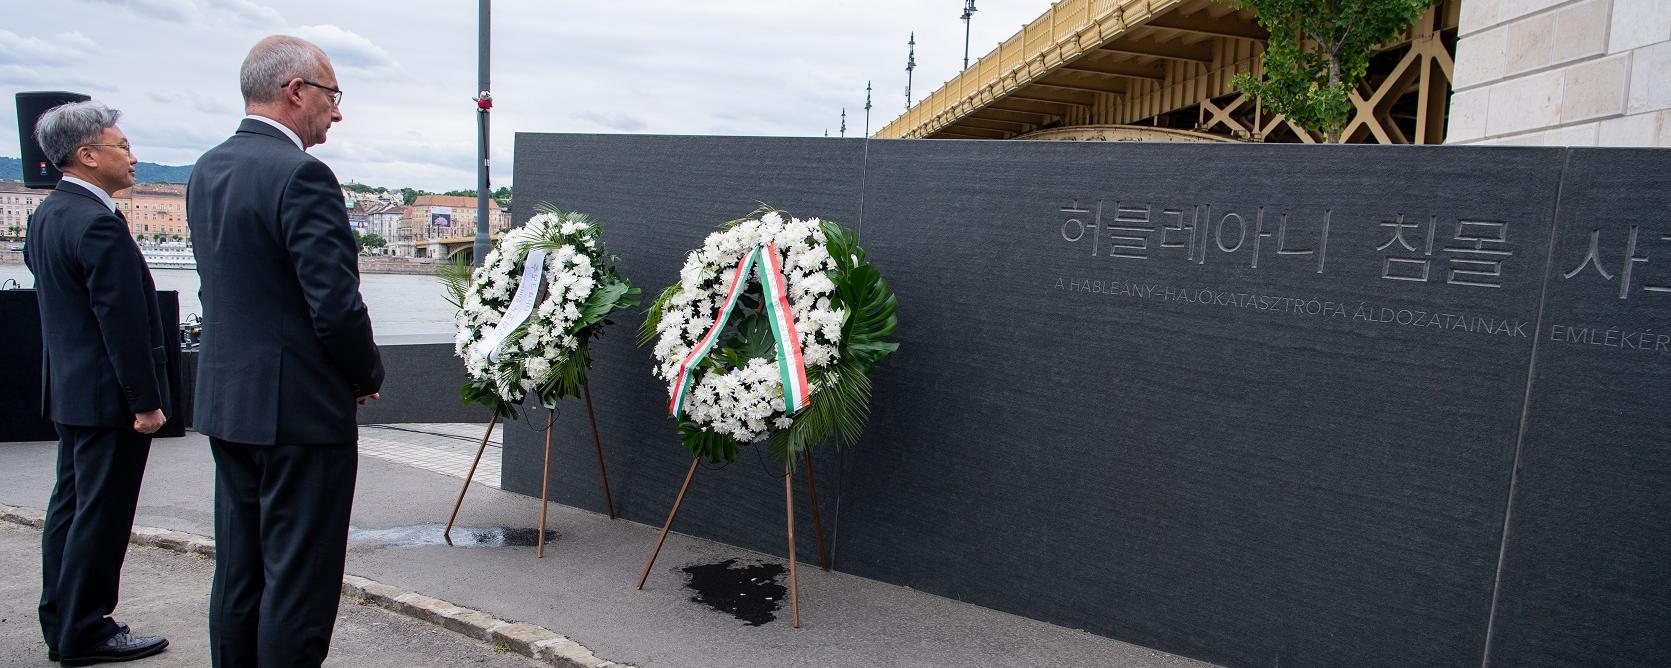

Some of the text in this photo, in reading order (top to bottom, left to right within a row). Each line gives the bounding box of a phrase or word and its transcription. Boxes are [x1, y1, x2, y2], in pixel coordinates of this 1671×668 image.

[1059, 199, 1332, 274] 허블레아니
[1376, 213, 1513, 288] 침몰
[1054, 277, 1065, 291] A
[1352, 301, 1529, 338] ÁLDOZATAINAK
